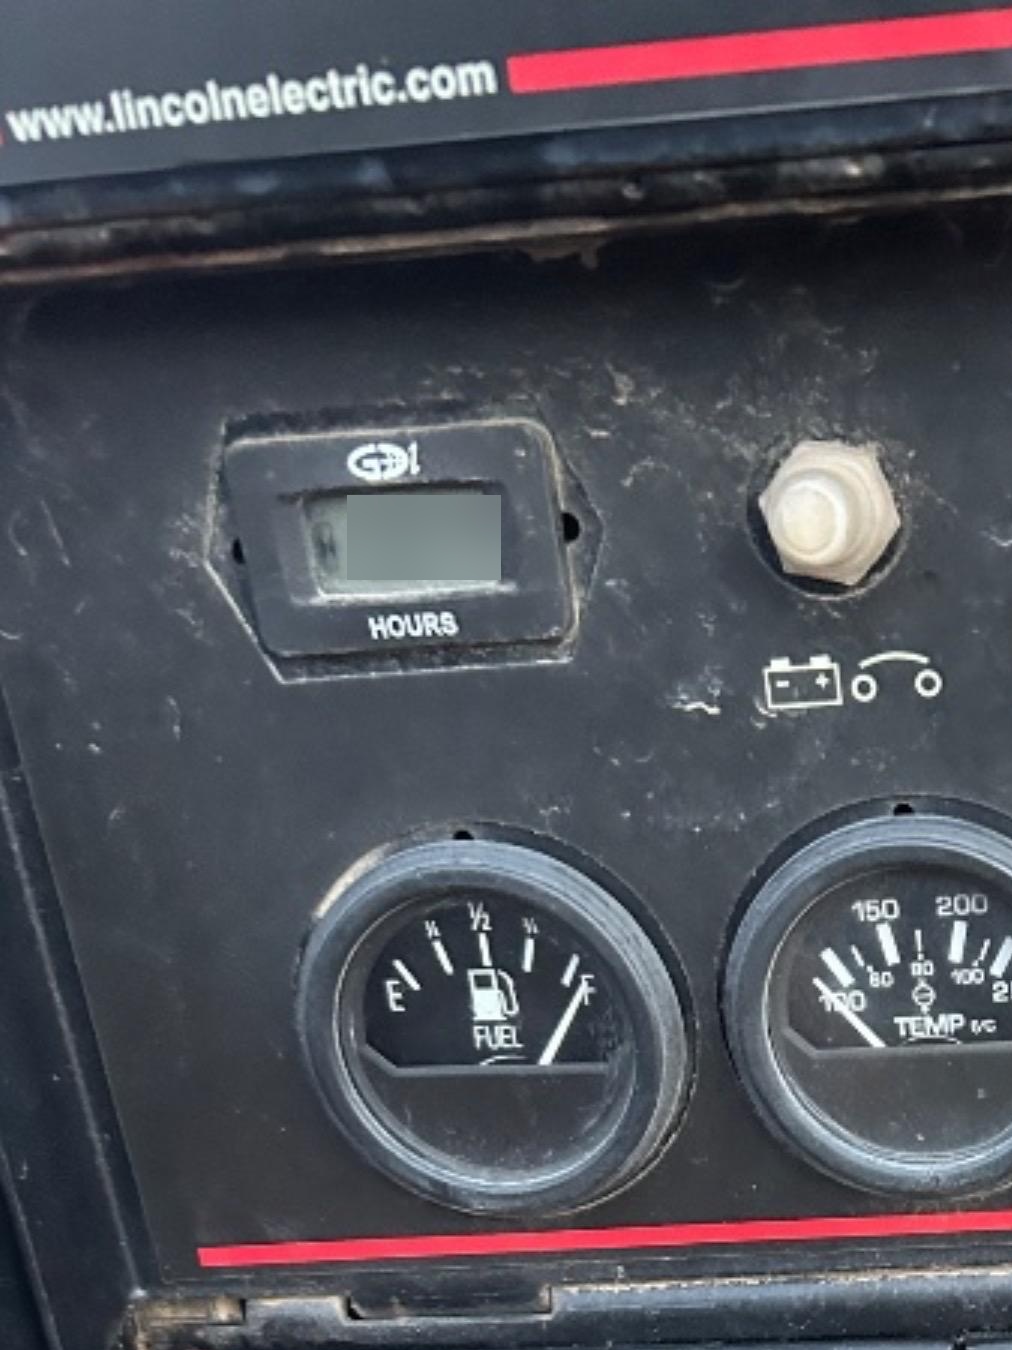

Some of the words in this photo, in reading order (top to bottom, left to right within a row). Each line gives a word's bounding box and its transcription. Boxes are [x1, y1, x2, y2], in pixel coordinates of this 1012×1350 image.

[8, 58, 498, 142] www.lincolnelectric.com
[367, 611, 460, 640] HOURS
[852, 898, 900, 921] 150
[935, 894, 988, 917] 200
[385, 980, 405, 1012] E
[472, 1025, 524, 1050] FUEL
[893, 1013, 966, 1037] TEMP
